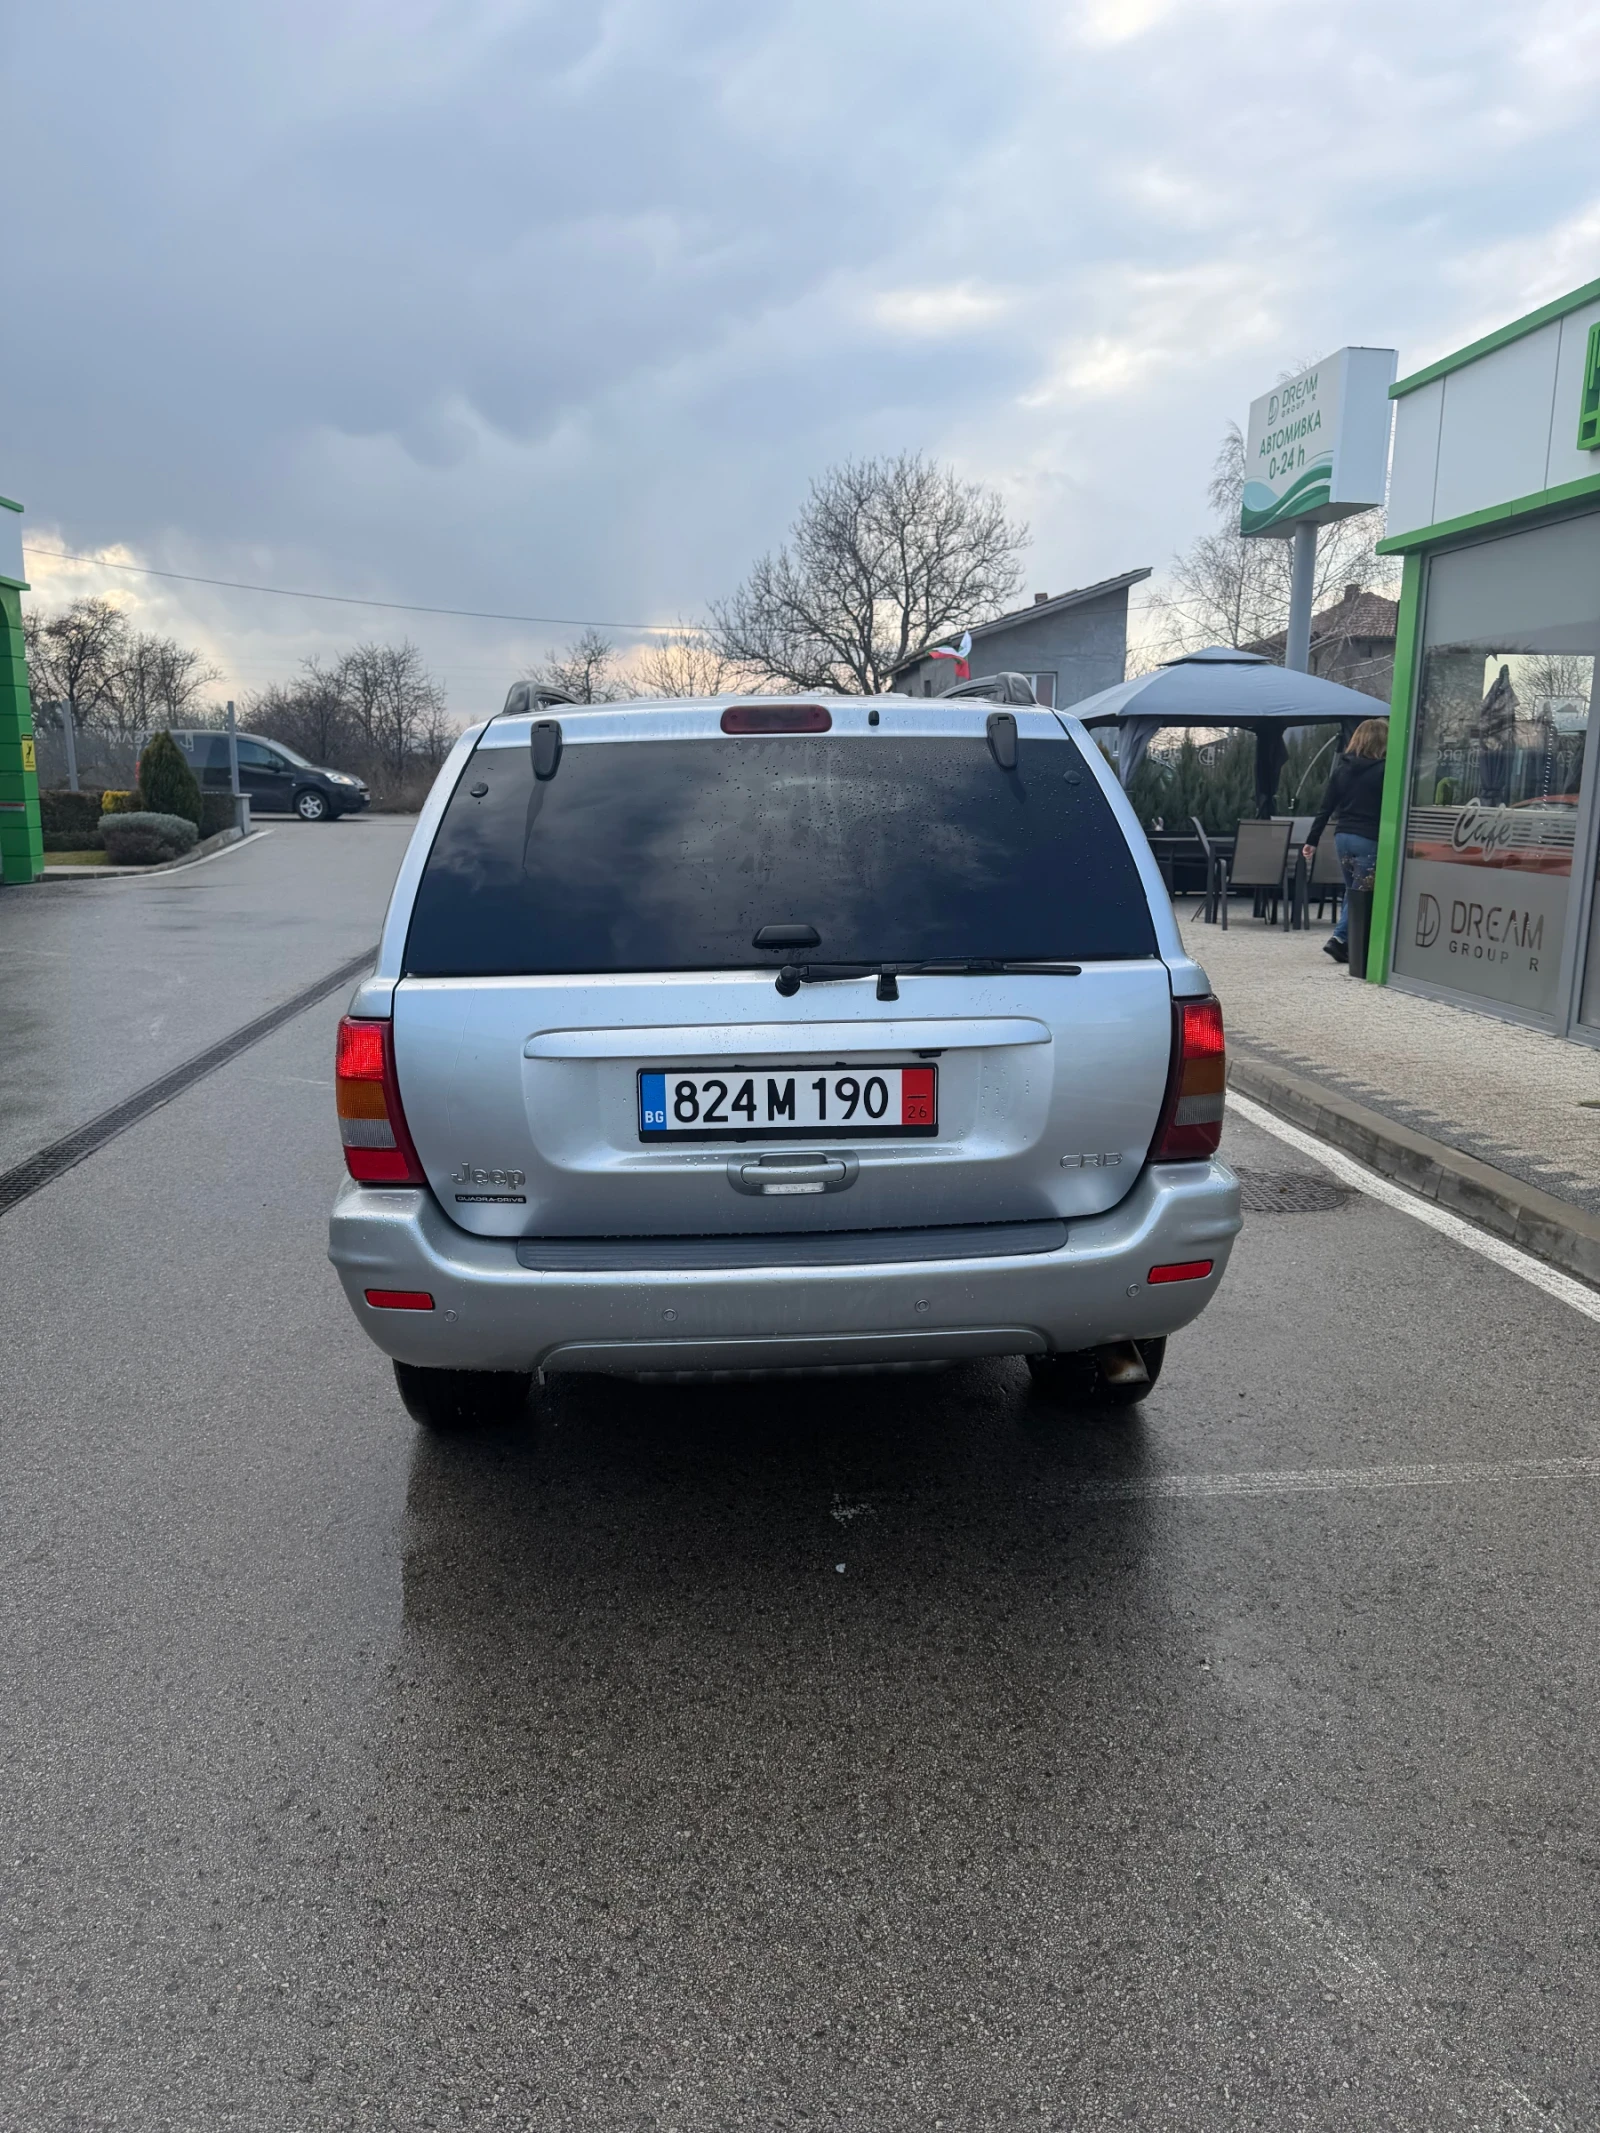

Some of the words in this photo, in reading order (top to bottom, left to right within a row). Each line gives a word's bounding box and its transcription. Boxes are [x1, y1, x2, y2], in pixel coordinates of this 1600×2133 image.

[1282, 372, 1319, 408] DREAM
[1281, 399, 1305, 418] GROUP
[1259, 409, 1321, 458] АВТОМИВКА
[1269, 447, 1294, 480] 0-24
[1297, 444, 1305, 467] h
[1451, 900, 1545, 951] DREAM
[1449, 940, 1509, 965] GROUP
[1529, 957, 1539, 972] R
[645, 1110, 664, 1124] BG
[673, 1079, 757, 1124] 824
[767, 1078, 796, 1121] M
[812, 1076, 889, 1121] 190
[907, 1104, 927, 1119] 26
[450, 1162, 526, 1190] Jeep
[1059, 1152, 1123, 1169] CRD
